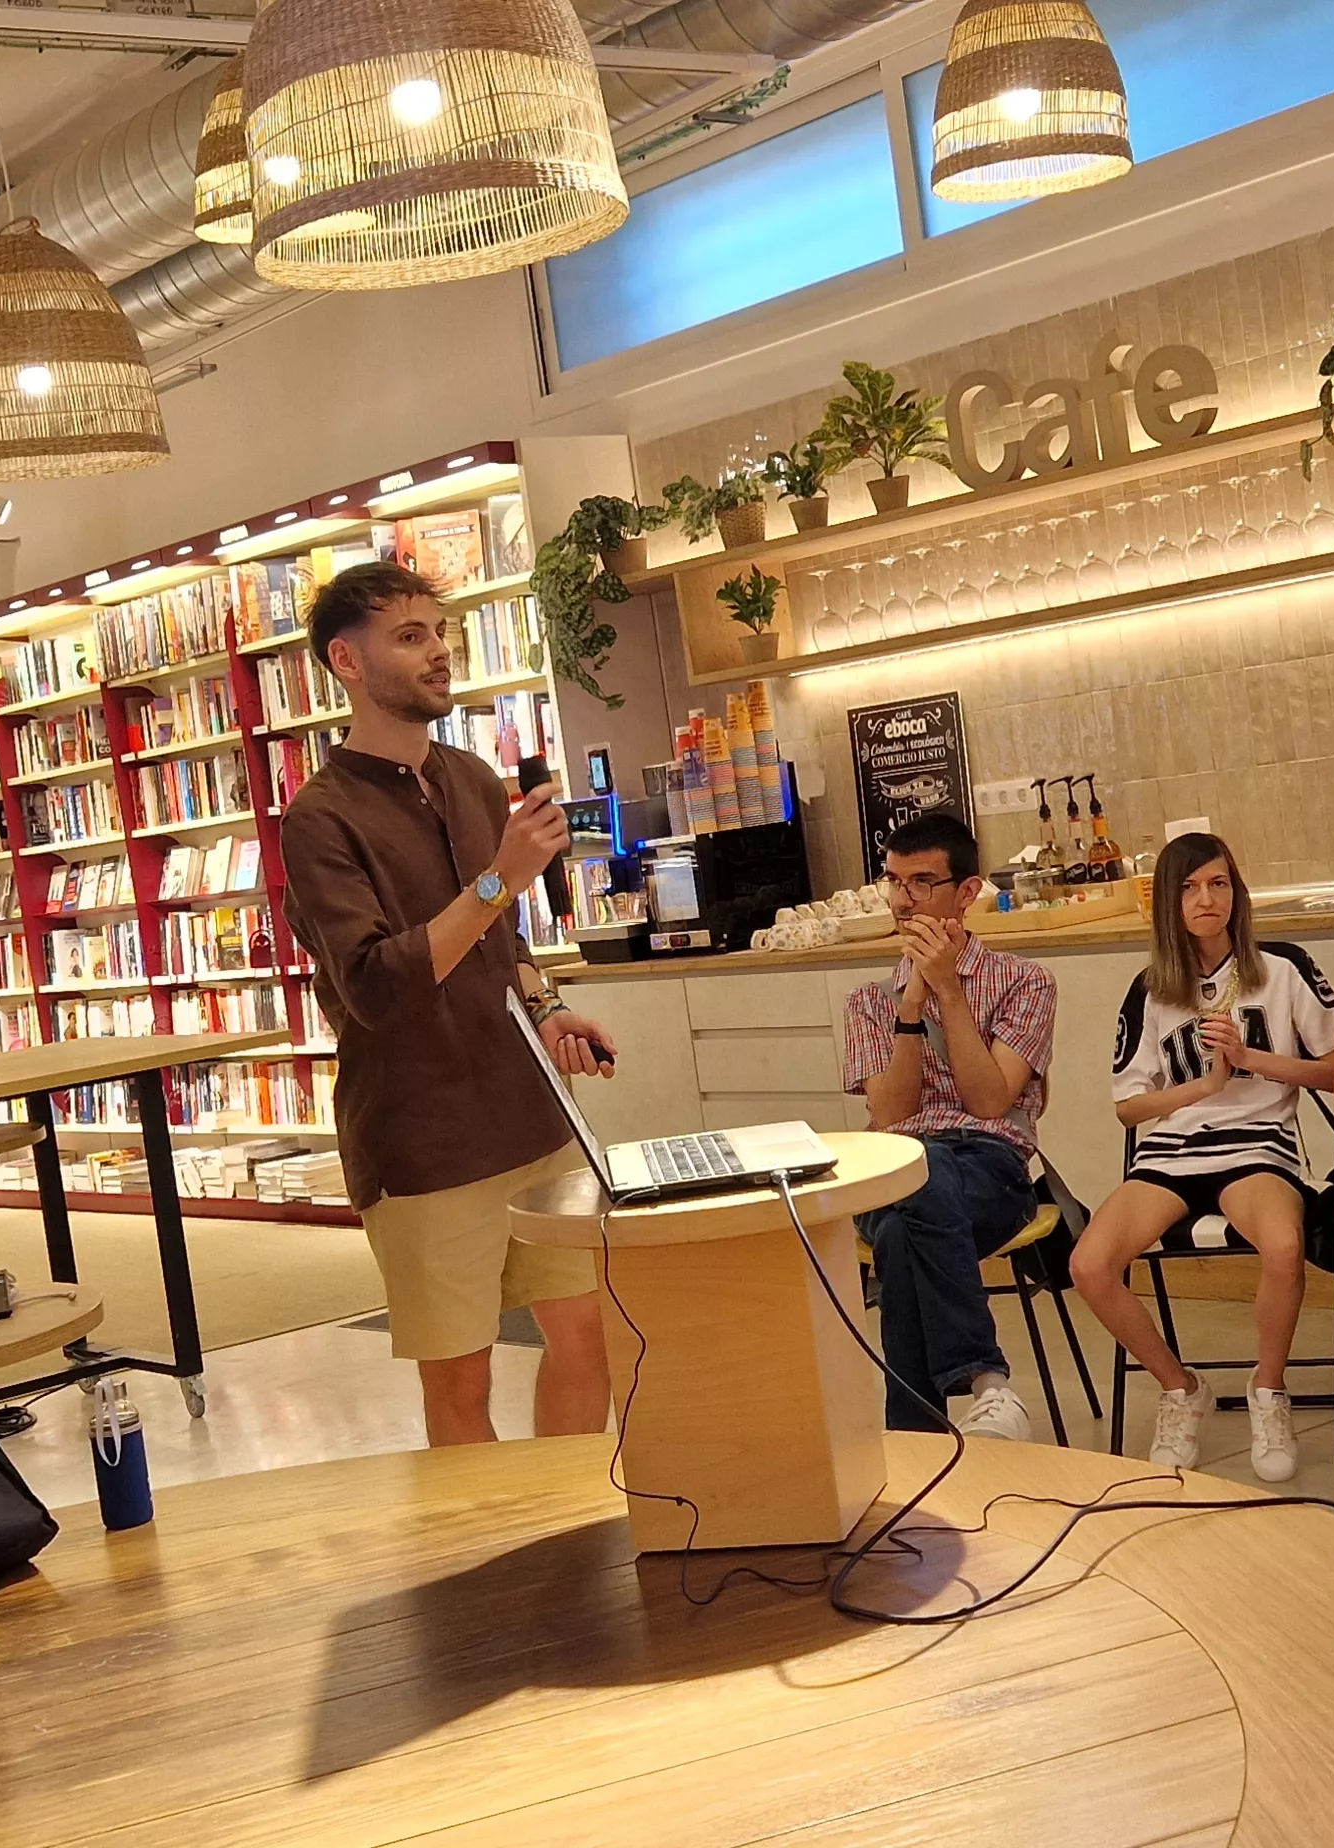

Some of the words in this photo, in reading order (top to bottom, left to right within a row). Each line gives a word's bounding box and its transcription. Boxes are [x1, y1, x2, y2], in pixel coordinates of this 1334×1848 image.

[945, 328, 1220, 488] Cafe
[884, 717, 927, 739] eboca
[871, 752, 917, 768] COMERCIO
[917, 746, 946, 762] JUSTO
